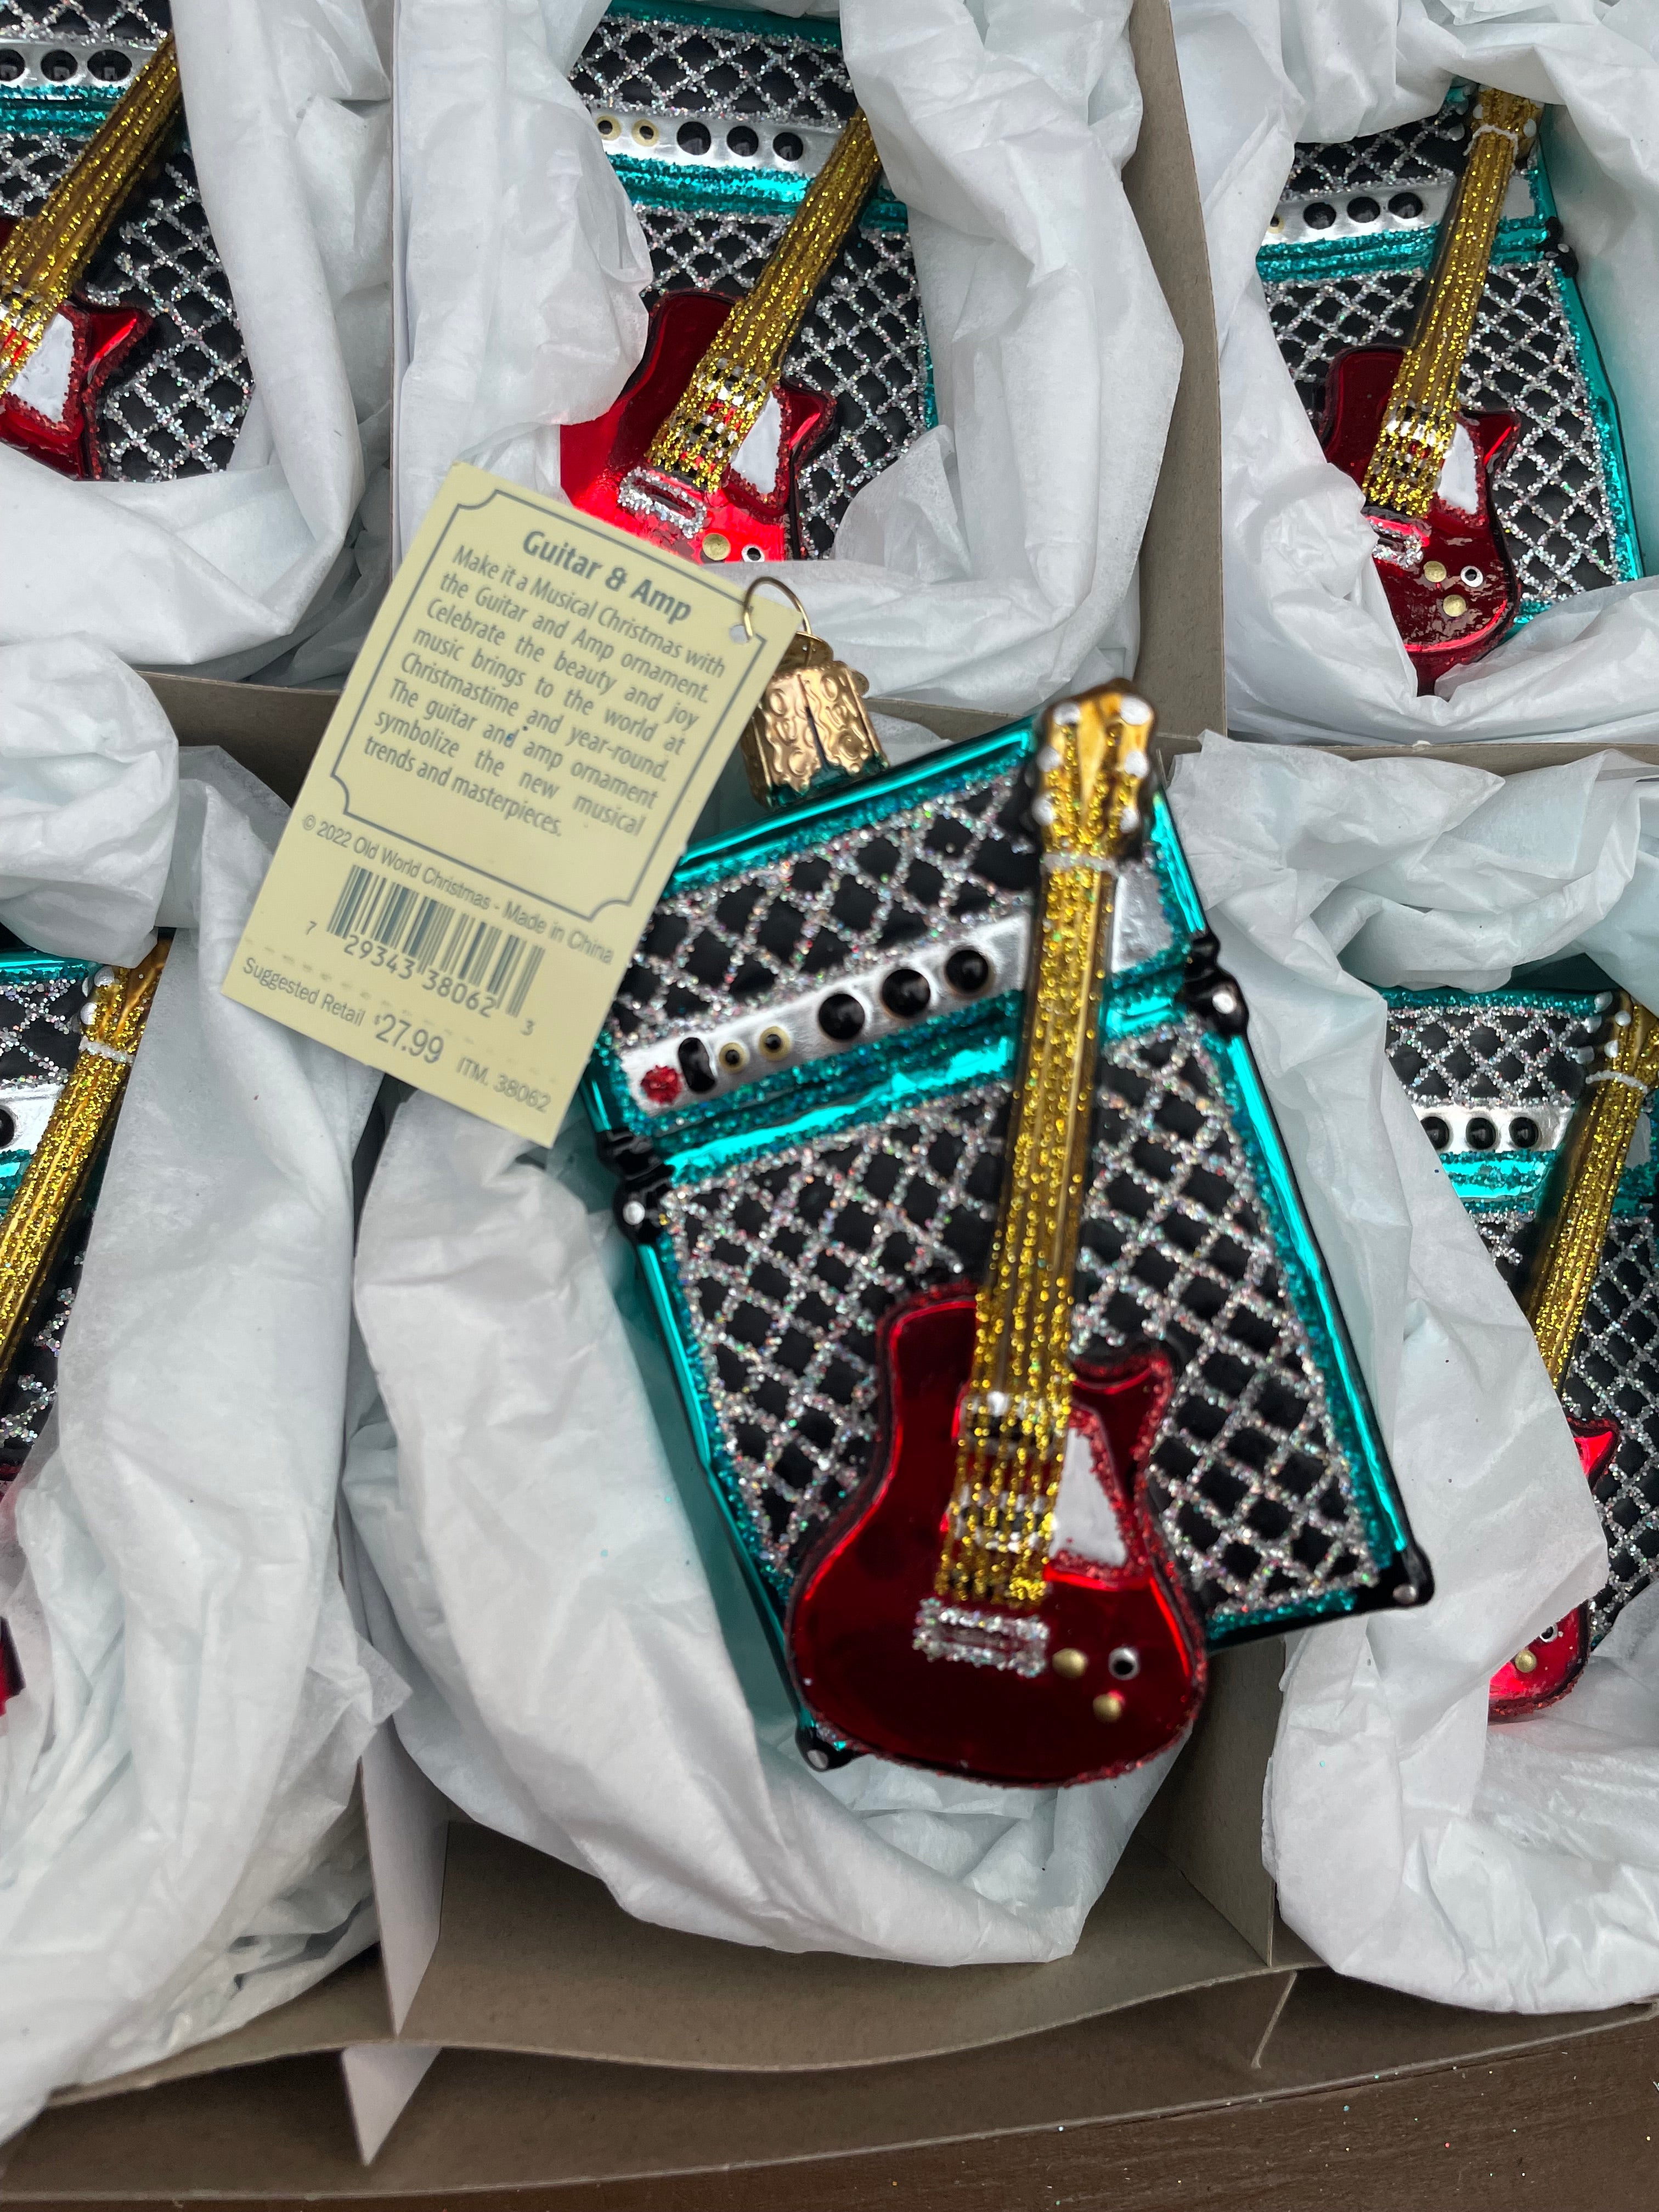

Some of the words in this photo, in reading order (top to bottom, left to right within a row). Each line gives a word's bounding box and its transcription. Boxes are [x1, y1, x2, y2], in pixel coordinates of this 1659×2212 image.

[439, 572, 469, 599] the
[475, 585, 529, 623] Guitar
[531, 614, 571, 639] and
[571, 628, 614, 662] Amp
[620, 652, 709, 703] ornament.
[452, 544, 499, 579] Make
[499, 565, 517, 586] it
[515, 575, 529, 591] a
[529, 576, 599, 620] Musical
[597, 606, 683, 658] Christmas
[685, 649, 725, 678] with
[522, 529, 604, 580] Guitar
[604, 565, 628, 592] &
[628, 578, 692, 625] Amp
[400, 651, 520, 717] Christmastime
[525, 709, 565, 735] and
[564, 726, 669, 782] year-round.
[412, 628, 465, 662] music
[470, 647, 527, 688] brings
[534, 675, 555, 698] to
[563, 688, 594, 716] the
[603, 708, 659, 742] world
[663, 736, 686, 755] at
[426, 597, 505, 646] Celebrate
[514, 635, 545, 662] the
[553, 650, 618, 696] beauty
[623, 686, 664, 712] and
[663, 701, 699, 732] joy
[363, 735, 416, 772] trends
[416, 761, 453, 787] and
[450, 776, 561, 837] masterpieces.
[374, 710, 460, 758] symbolize
[474, 749, 505, 777] the
[518, 771, 560, 799] new
[573, 794, 646, 836] musical
[389, 677, 419, 708] The
[422, 699, 478, 731] guitar
[482, 723, 520, 749] and
[522, 740, 563, 771] amp
[569, 761, 658, 809] ornament
[315, 820, 352, 848] 2022
[353, 836, 380, 860] Old
[380, 847, 422, 878] World
[421, 866, 491, 910] Christmas
[502, 900, 547, 934] Made
[549, 923, 565, 941] in
[567, 929, 613, 964] China
[242, 956, 320, 1005] Suggested
[320, 992, 366, 1026] Retail
[374, 1012, 444, 1064] $27.99
[456, 1057, 489, 1086] ITM.
[493, 1074, 551, 1113] 38062
[306, 920, 317, 935] 7
[343, 935, 415, 980] 29343
[421, 973, 498, 1018] 38062
[521, 1019, 534, 1036] 3
